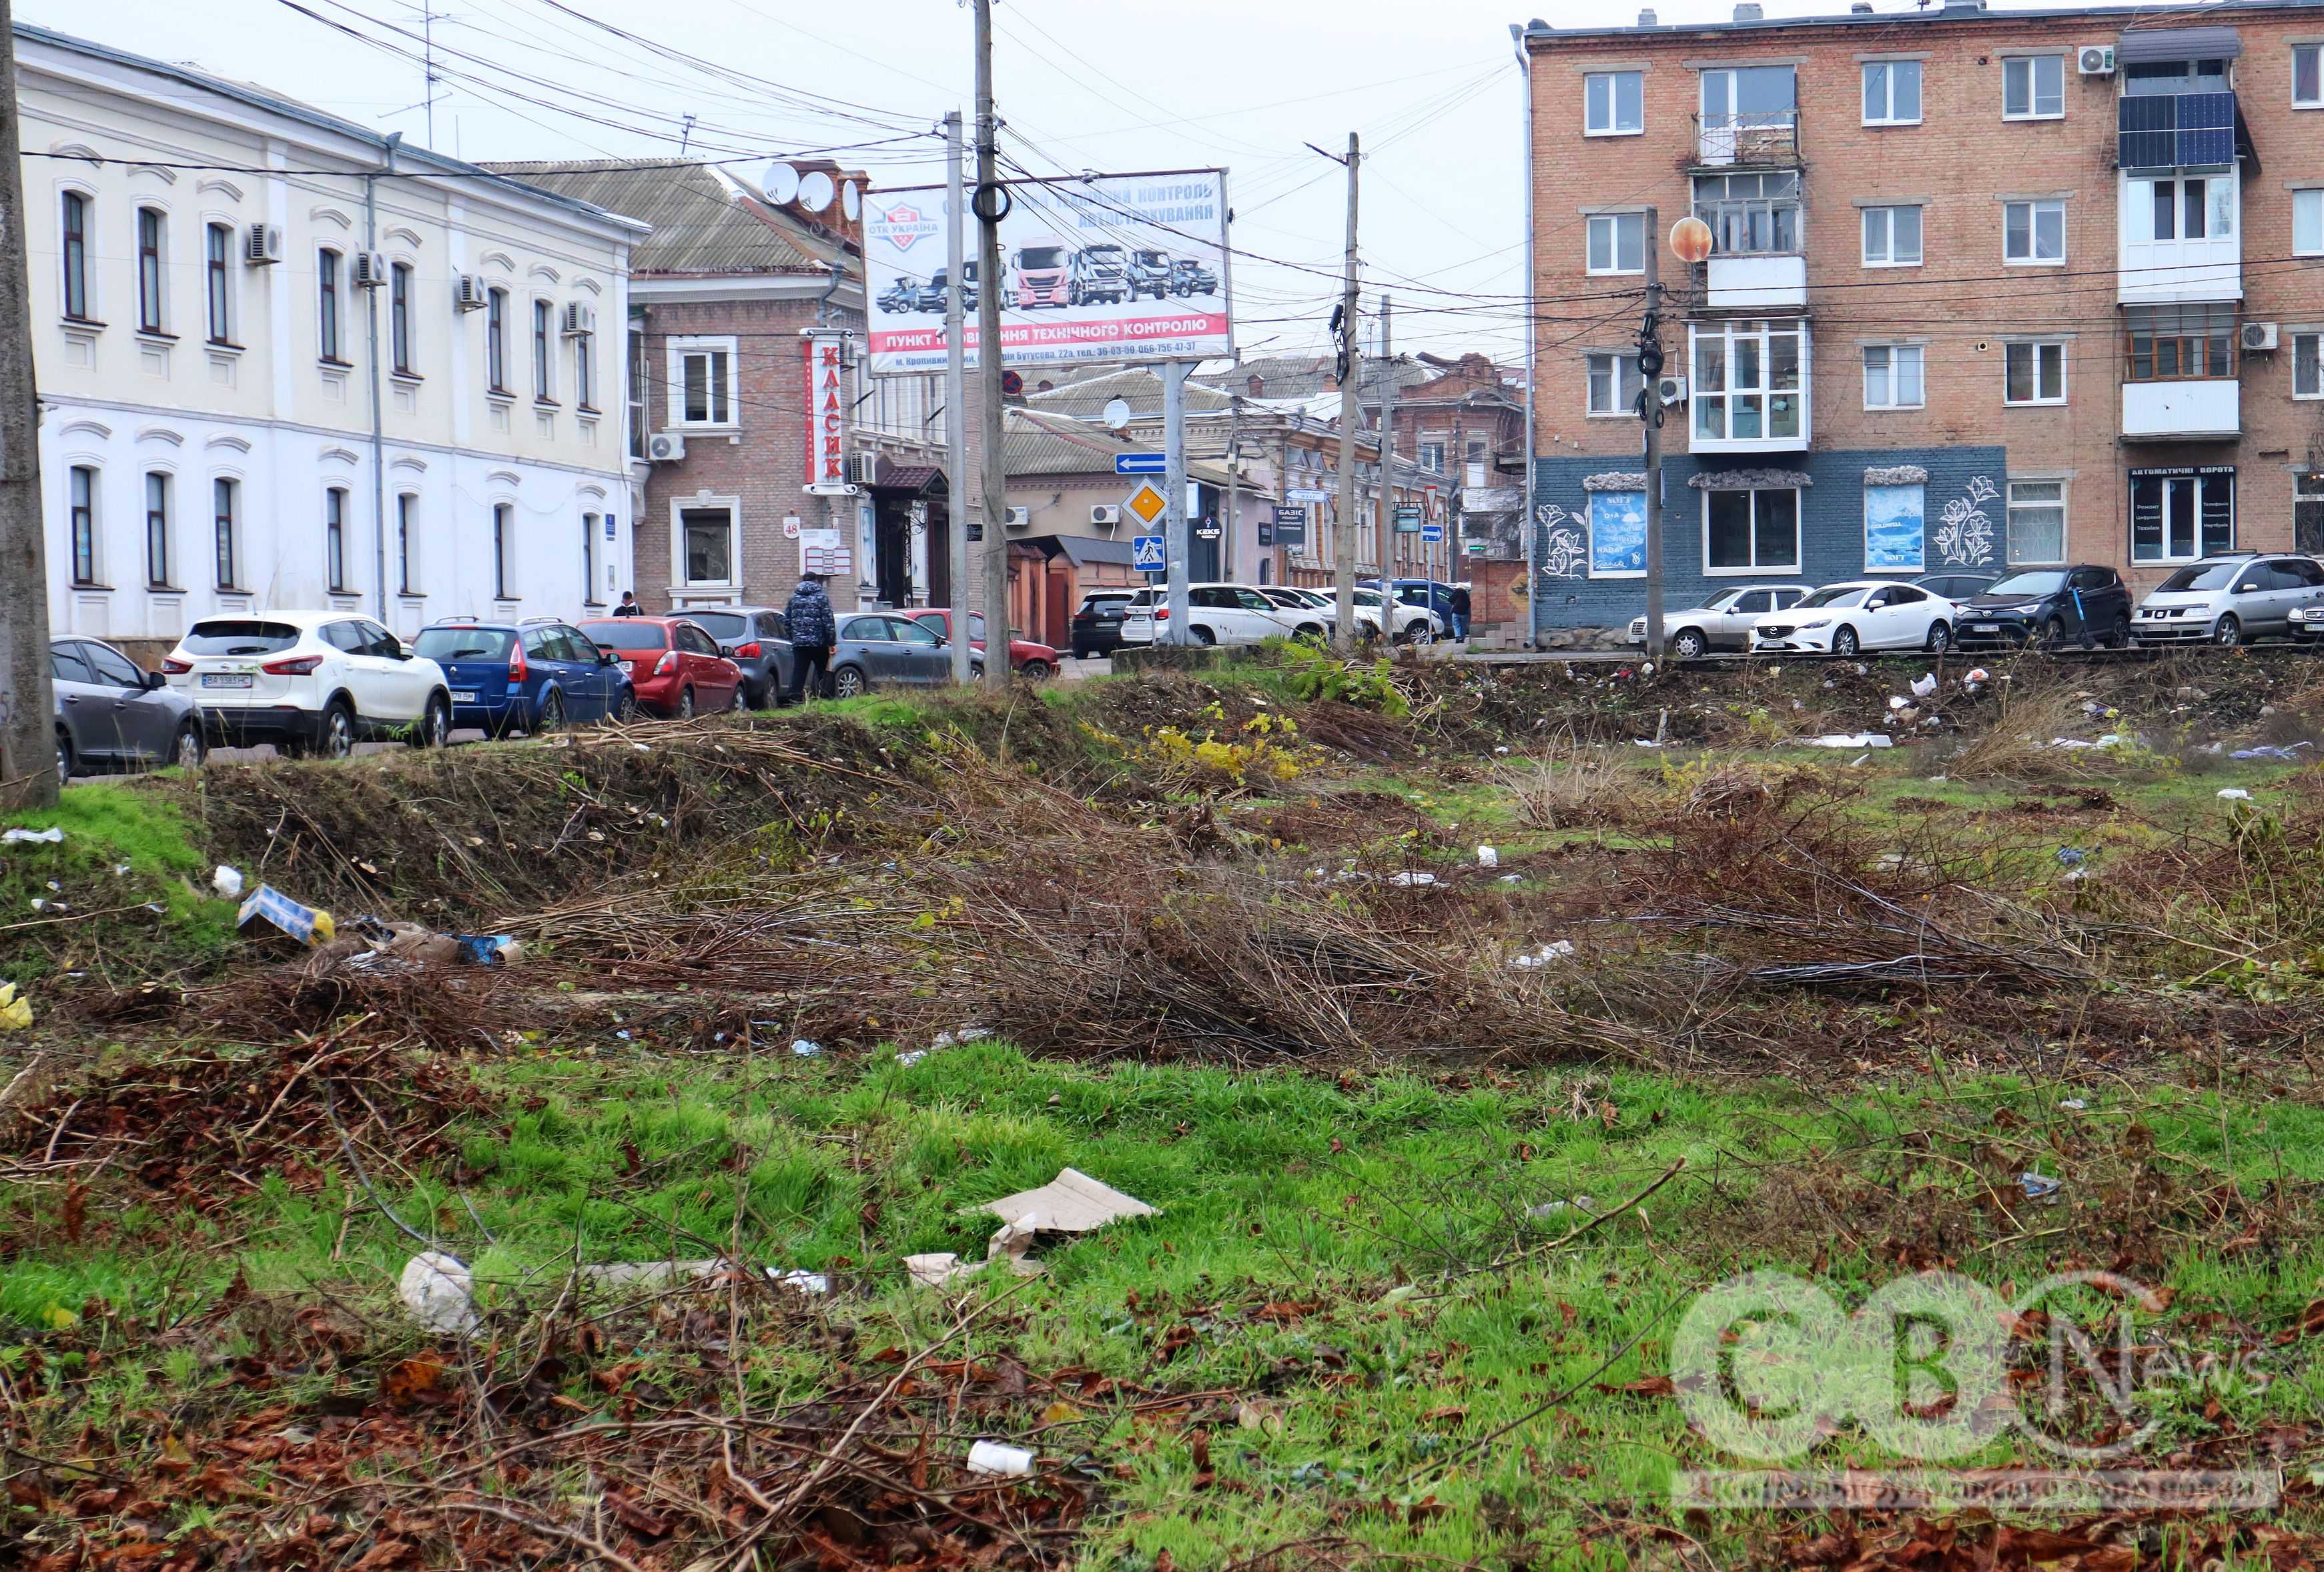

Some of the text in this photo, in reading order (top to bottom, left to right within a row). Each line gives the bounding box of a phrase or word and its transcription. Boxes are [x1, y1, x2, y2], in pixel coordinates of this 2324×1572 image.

[1138, 183, 1212, 204] КОНТРОЛЬ
[869, 223, 938, 234] ОТК УКРАЇНА
[886, 334, 931, 347] ПУНКТ
[1034, 324, 1119, 340] ТЕХНІЧНОГО
[1124, 319, 1207, 335] КОНТРОЛЮ
[821, 346, 843, 478] КЛАСИК
[2132, 468, 2195, 476] АВТОМАТИЧНІ
[785, 524, 798, 534] 48
